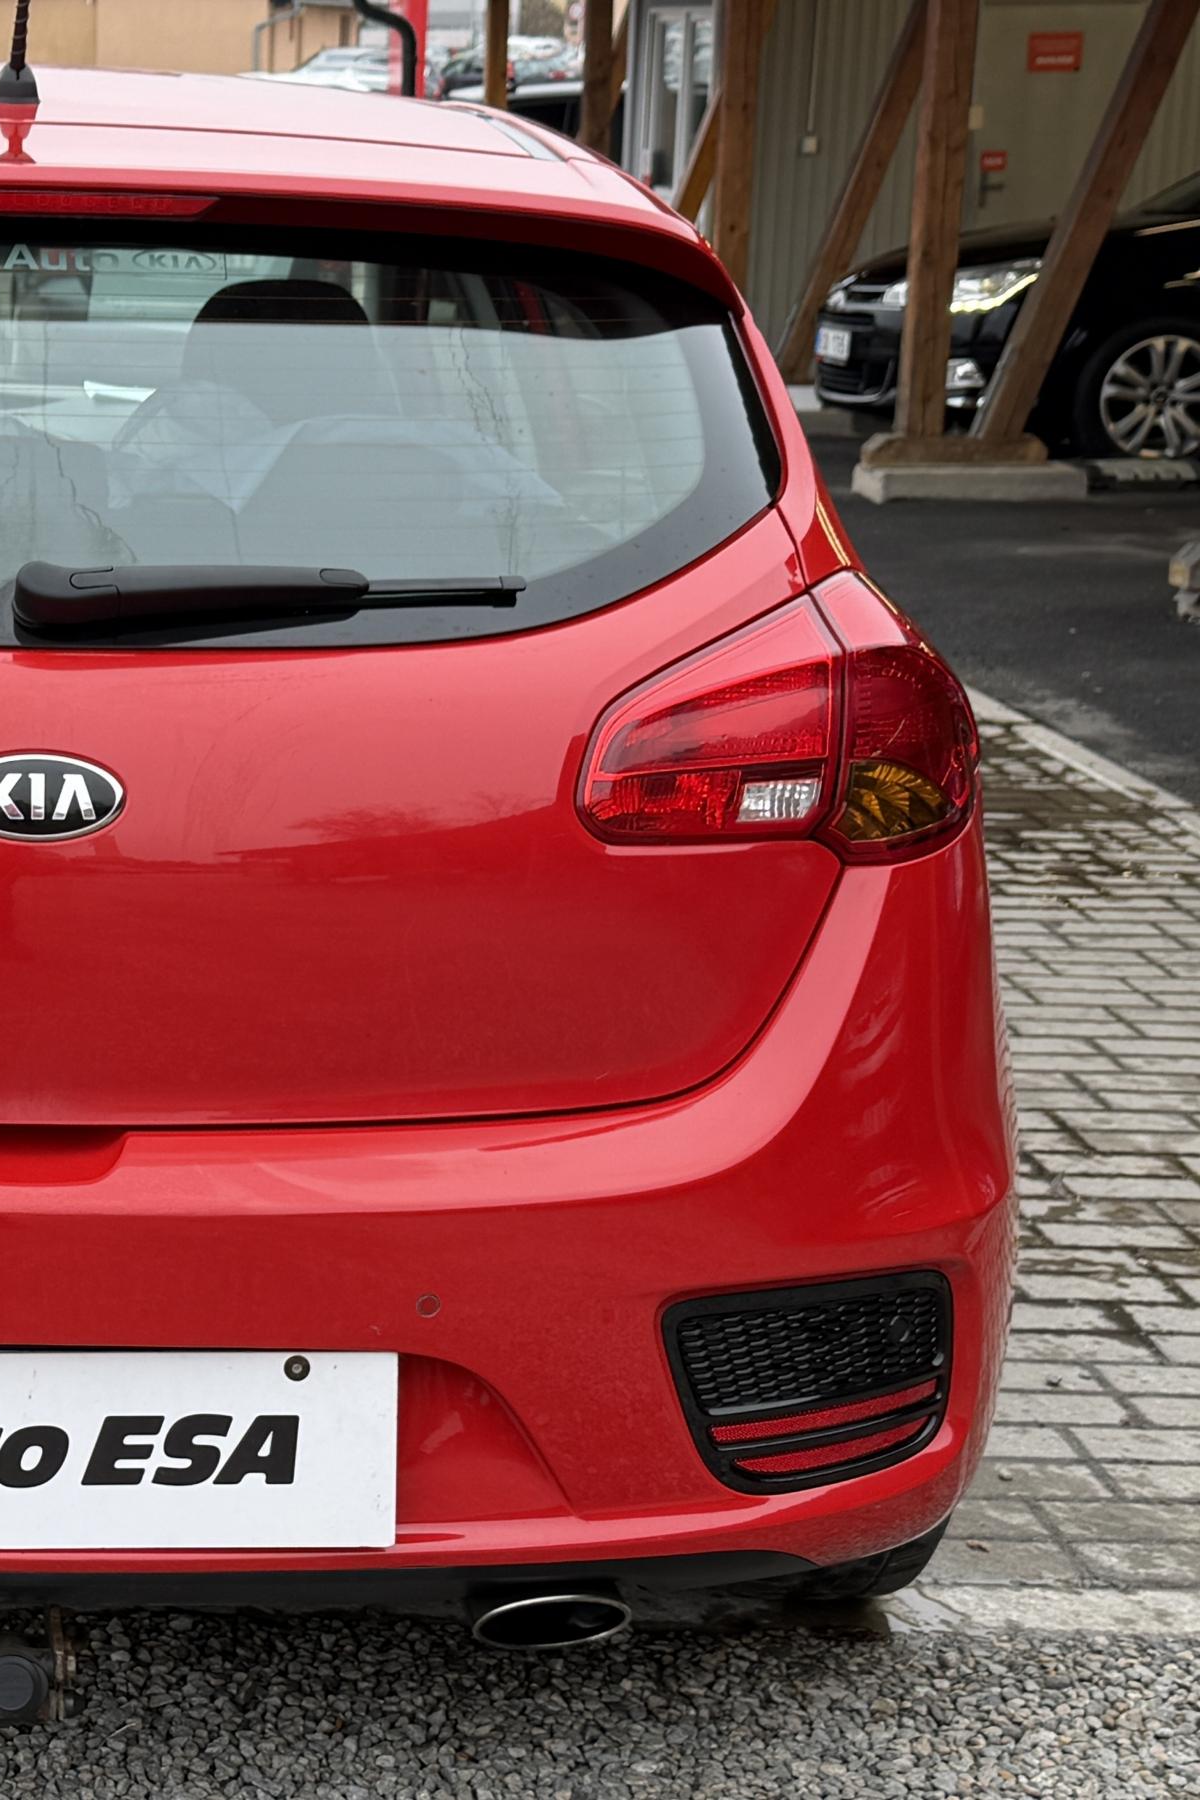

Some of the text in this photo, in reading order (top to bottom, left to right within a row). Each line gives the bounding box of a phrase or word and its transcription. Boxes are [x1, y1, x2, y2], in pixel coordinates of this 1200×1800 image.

[3, 244, 119, 271] Auto
[152, 253, 206, 269] KIA
[81, 1413, 300, 1487] ESA
